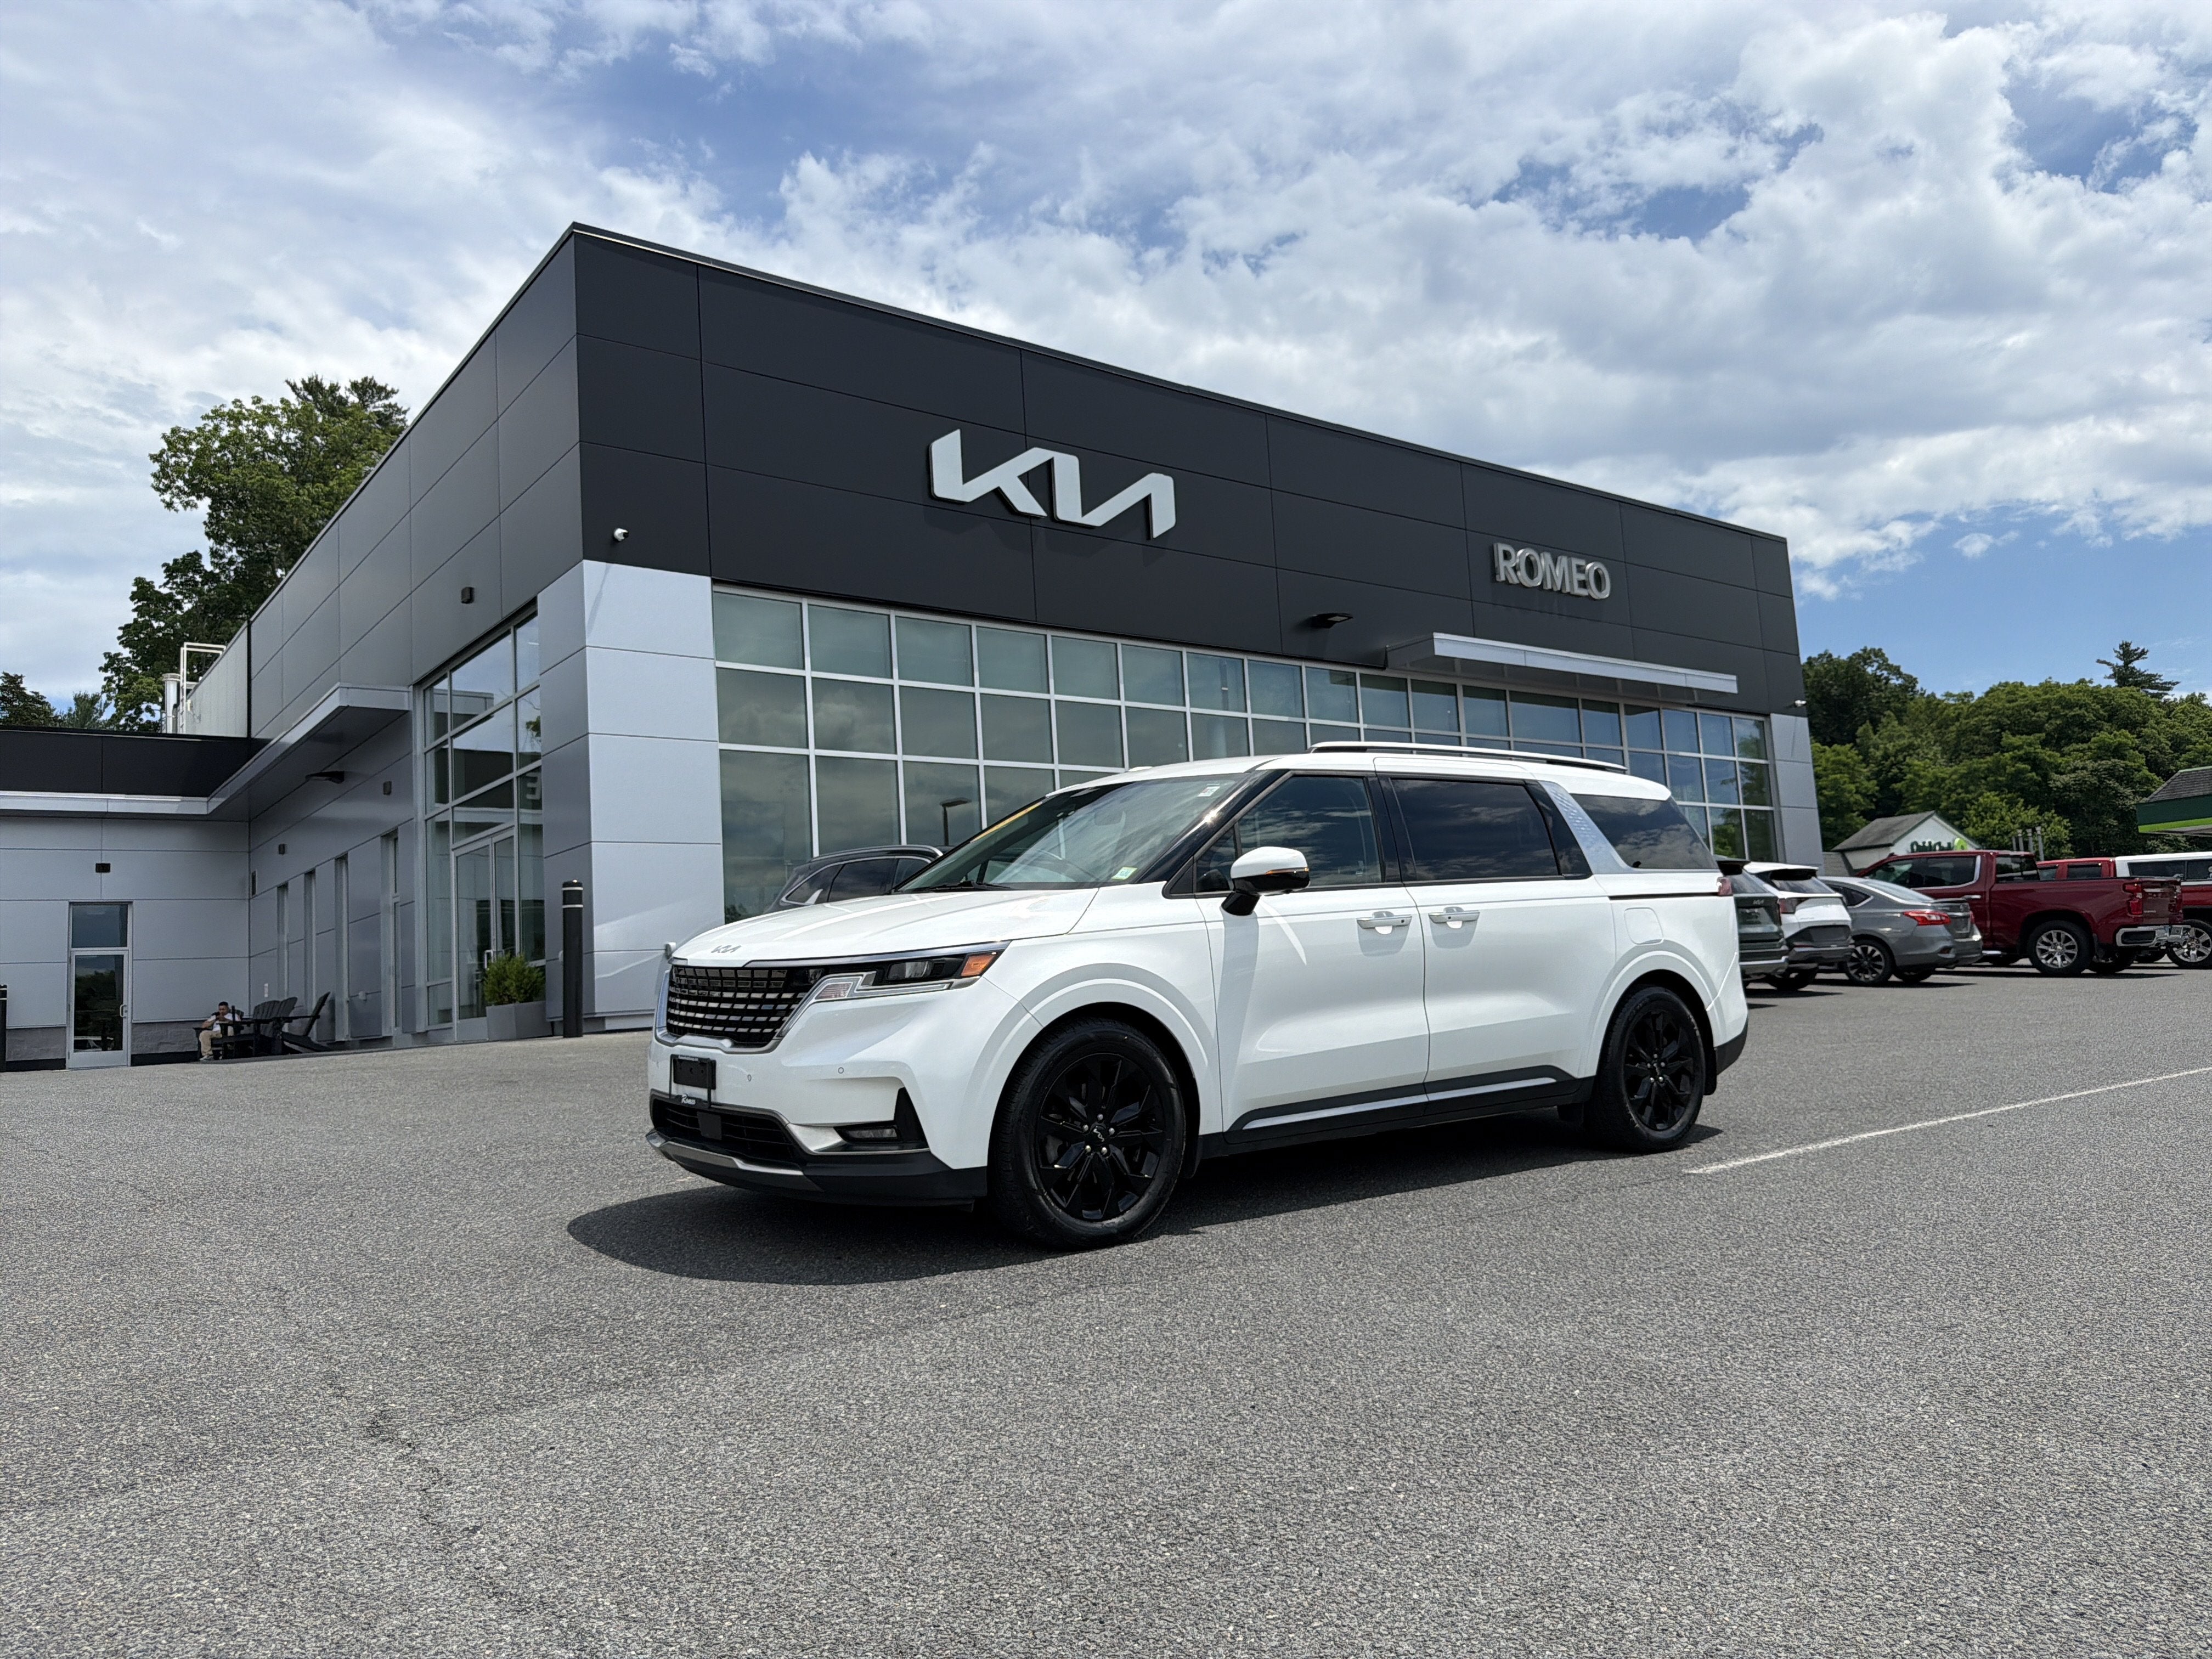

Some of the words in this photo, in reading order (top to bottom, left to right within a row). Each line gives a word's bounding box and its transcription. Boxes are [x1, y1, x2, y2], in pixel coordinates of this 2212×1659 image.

[929, 428, 1176, 538] KIA
[1493, 543, 1611, 600] ROMEO
[711, 945, 742, 953] KIA
